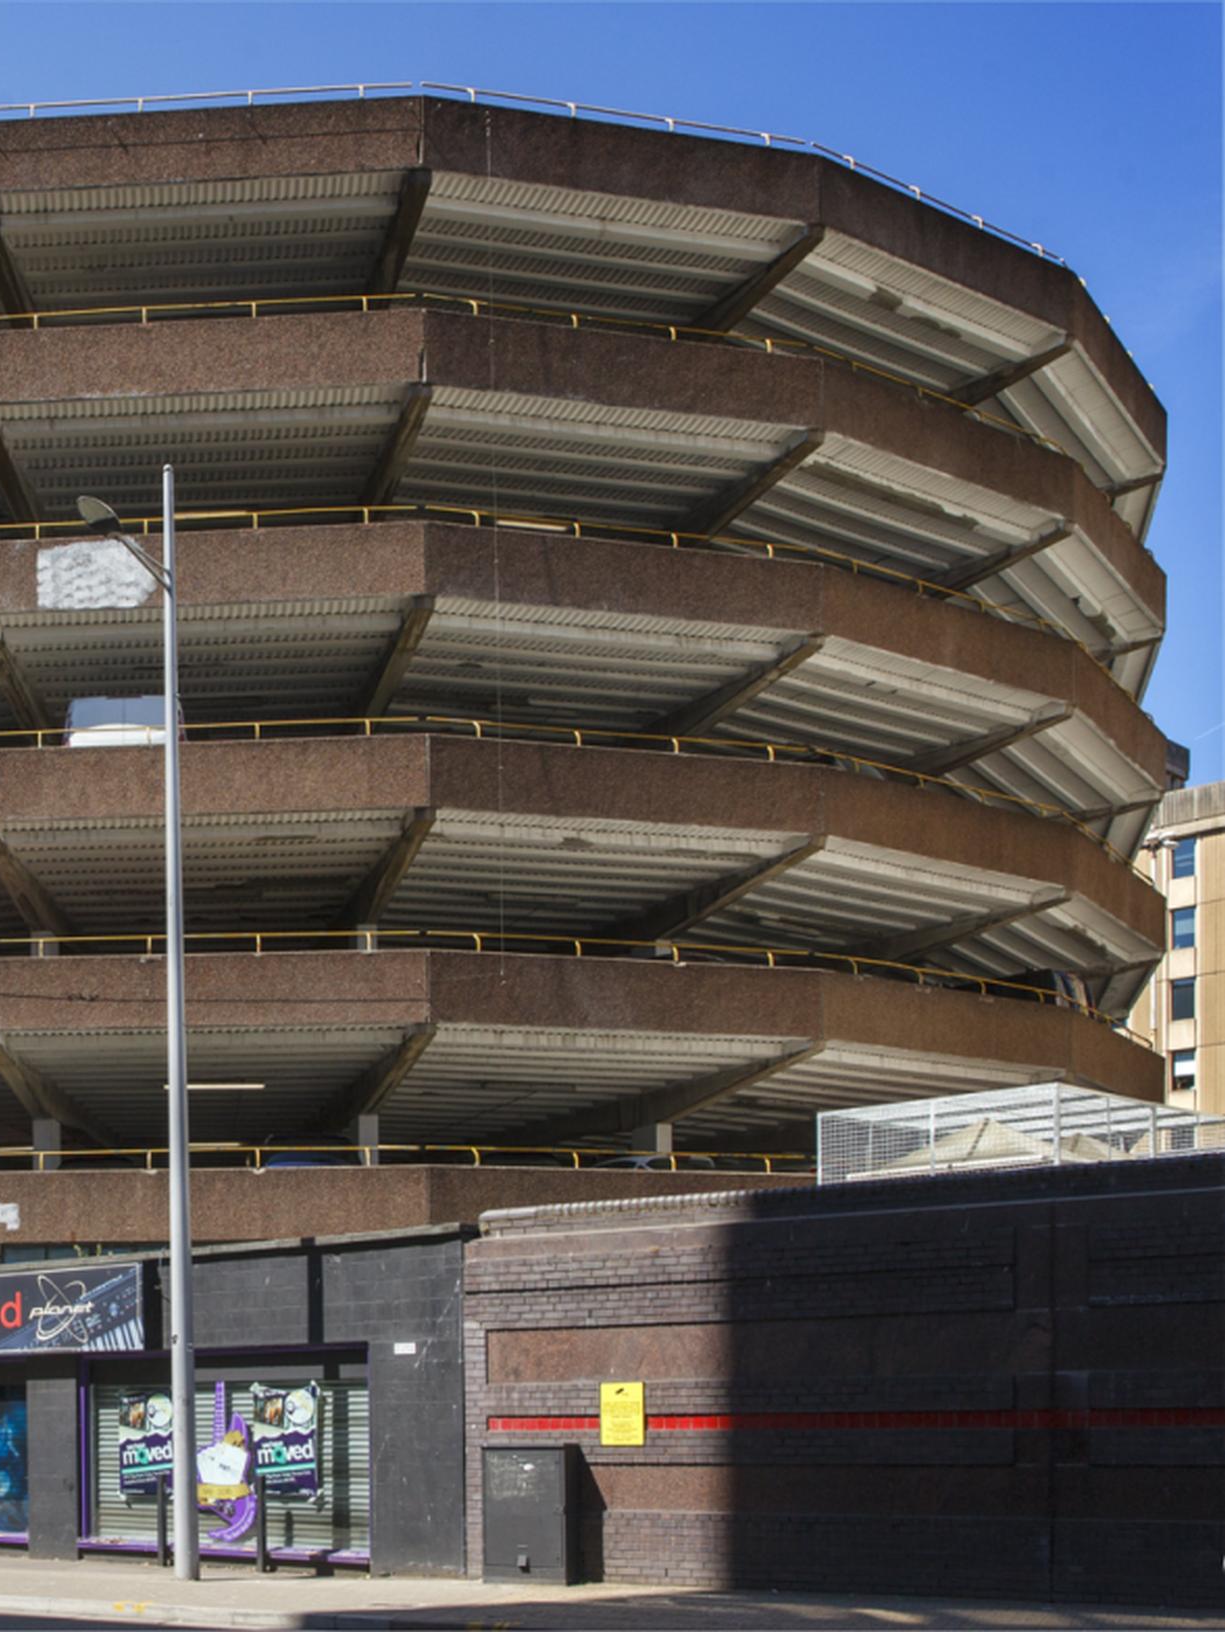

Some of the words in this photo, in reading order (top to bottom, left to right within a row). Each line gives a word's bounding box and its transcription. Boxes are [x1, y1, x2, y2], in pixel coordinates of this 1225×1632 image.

[28, 1300, 95, 1320] planet
[122, 1441, 172, 1466] moved
[257, 1438, 314, 1465] moved
